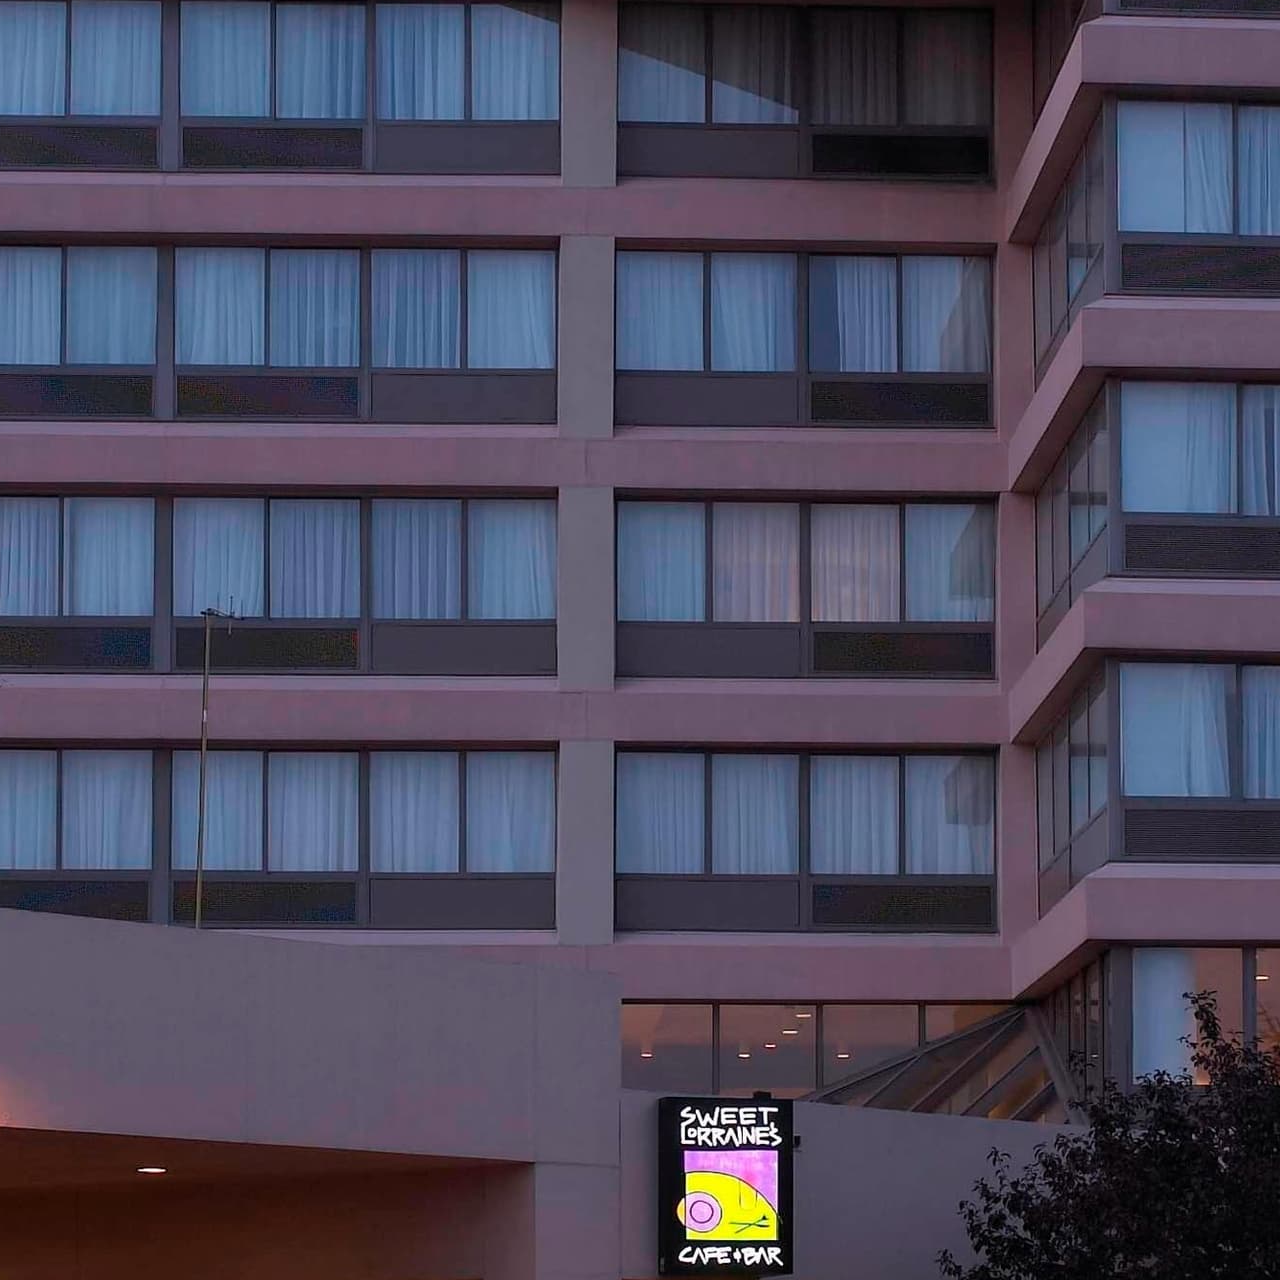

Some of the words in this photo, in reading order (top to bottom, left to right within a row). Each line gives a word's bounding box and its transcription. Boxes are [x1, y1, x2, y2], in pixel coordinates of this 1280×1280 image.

[680, 1106, 779, 1127] SWEET
[678, 1246, 732, 1266] CAFE
[741, 1246, 784, 1267] BAR
